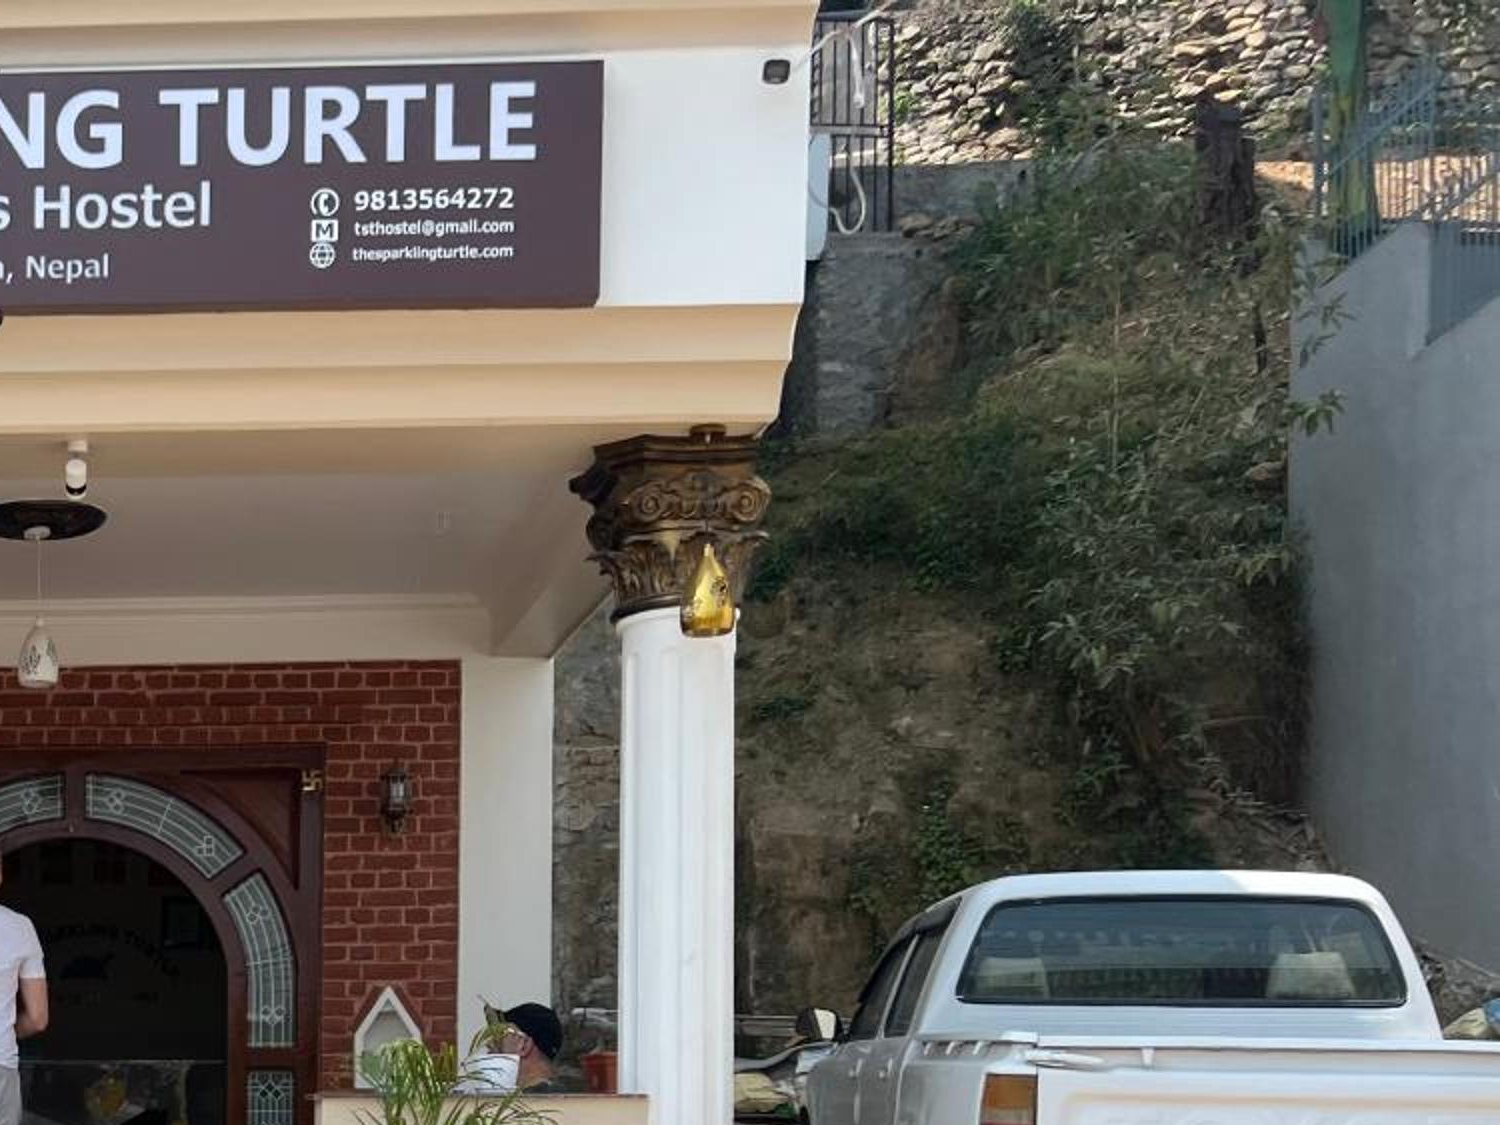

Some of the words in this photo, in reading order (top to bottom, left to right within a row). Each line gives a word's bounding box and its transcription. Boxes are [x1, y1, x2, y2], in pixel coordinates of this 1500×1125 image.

[158, 81, 537, 166] TURTLE
[34, 180, 211, 229] Hostel
[353, 187, 515, 212] 9813564272
[353, 218, 515, 238] tsthostel@gmail.com
[351, 244, 514, 263] thesparklingturtle.com
[26, 253, 109, 284] Nepal
